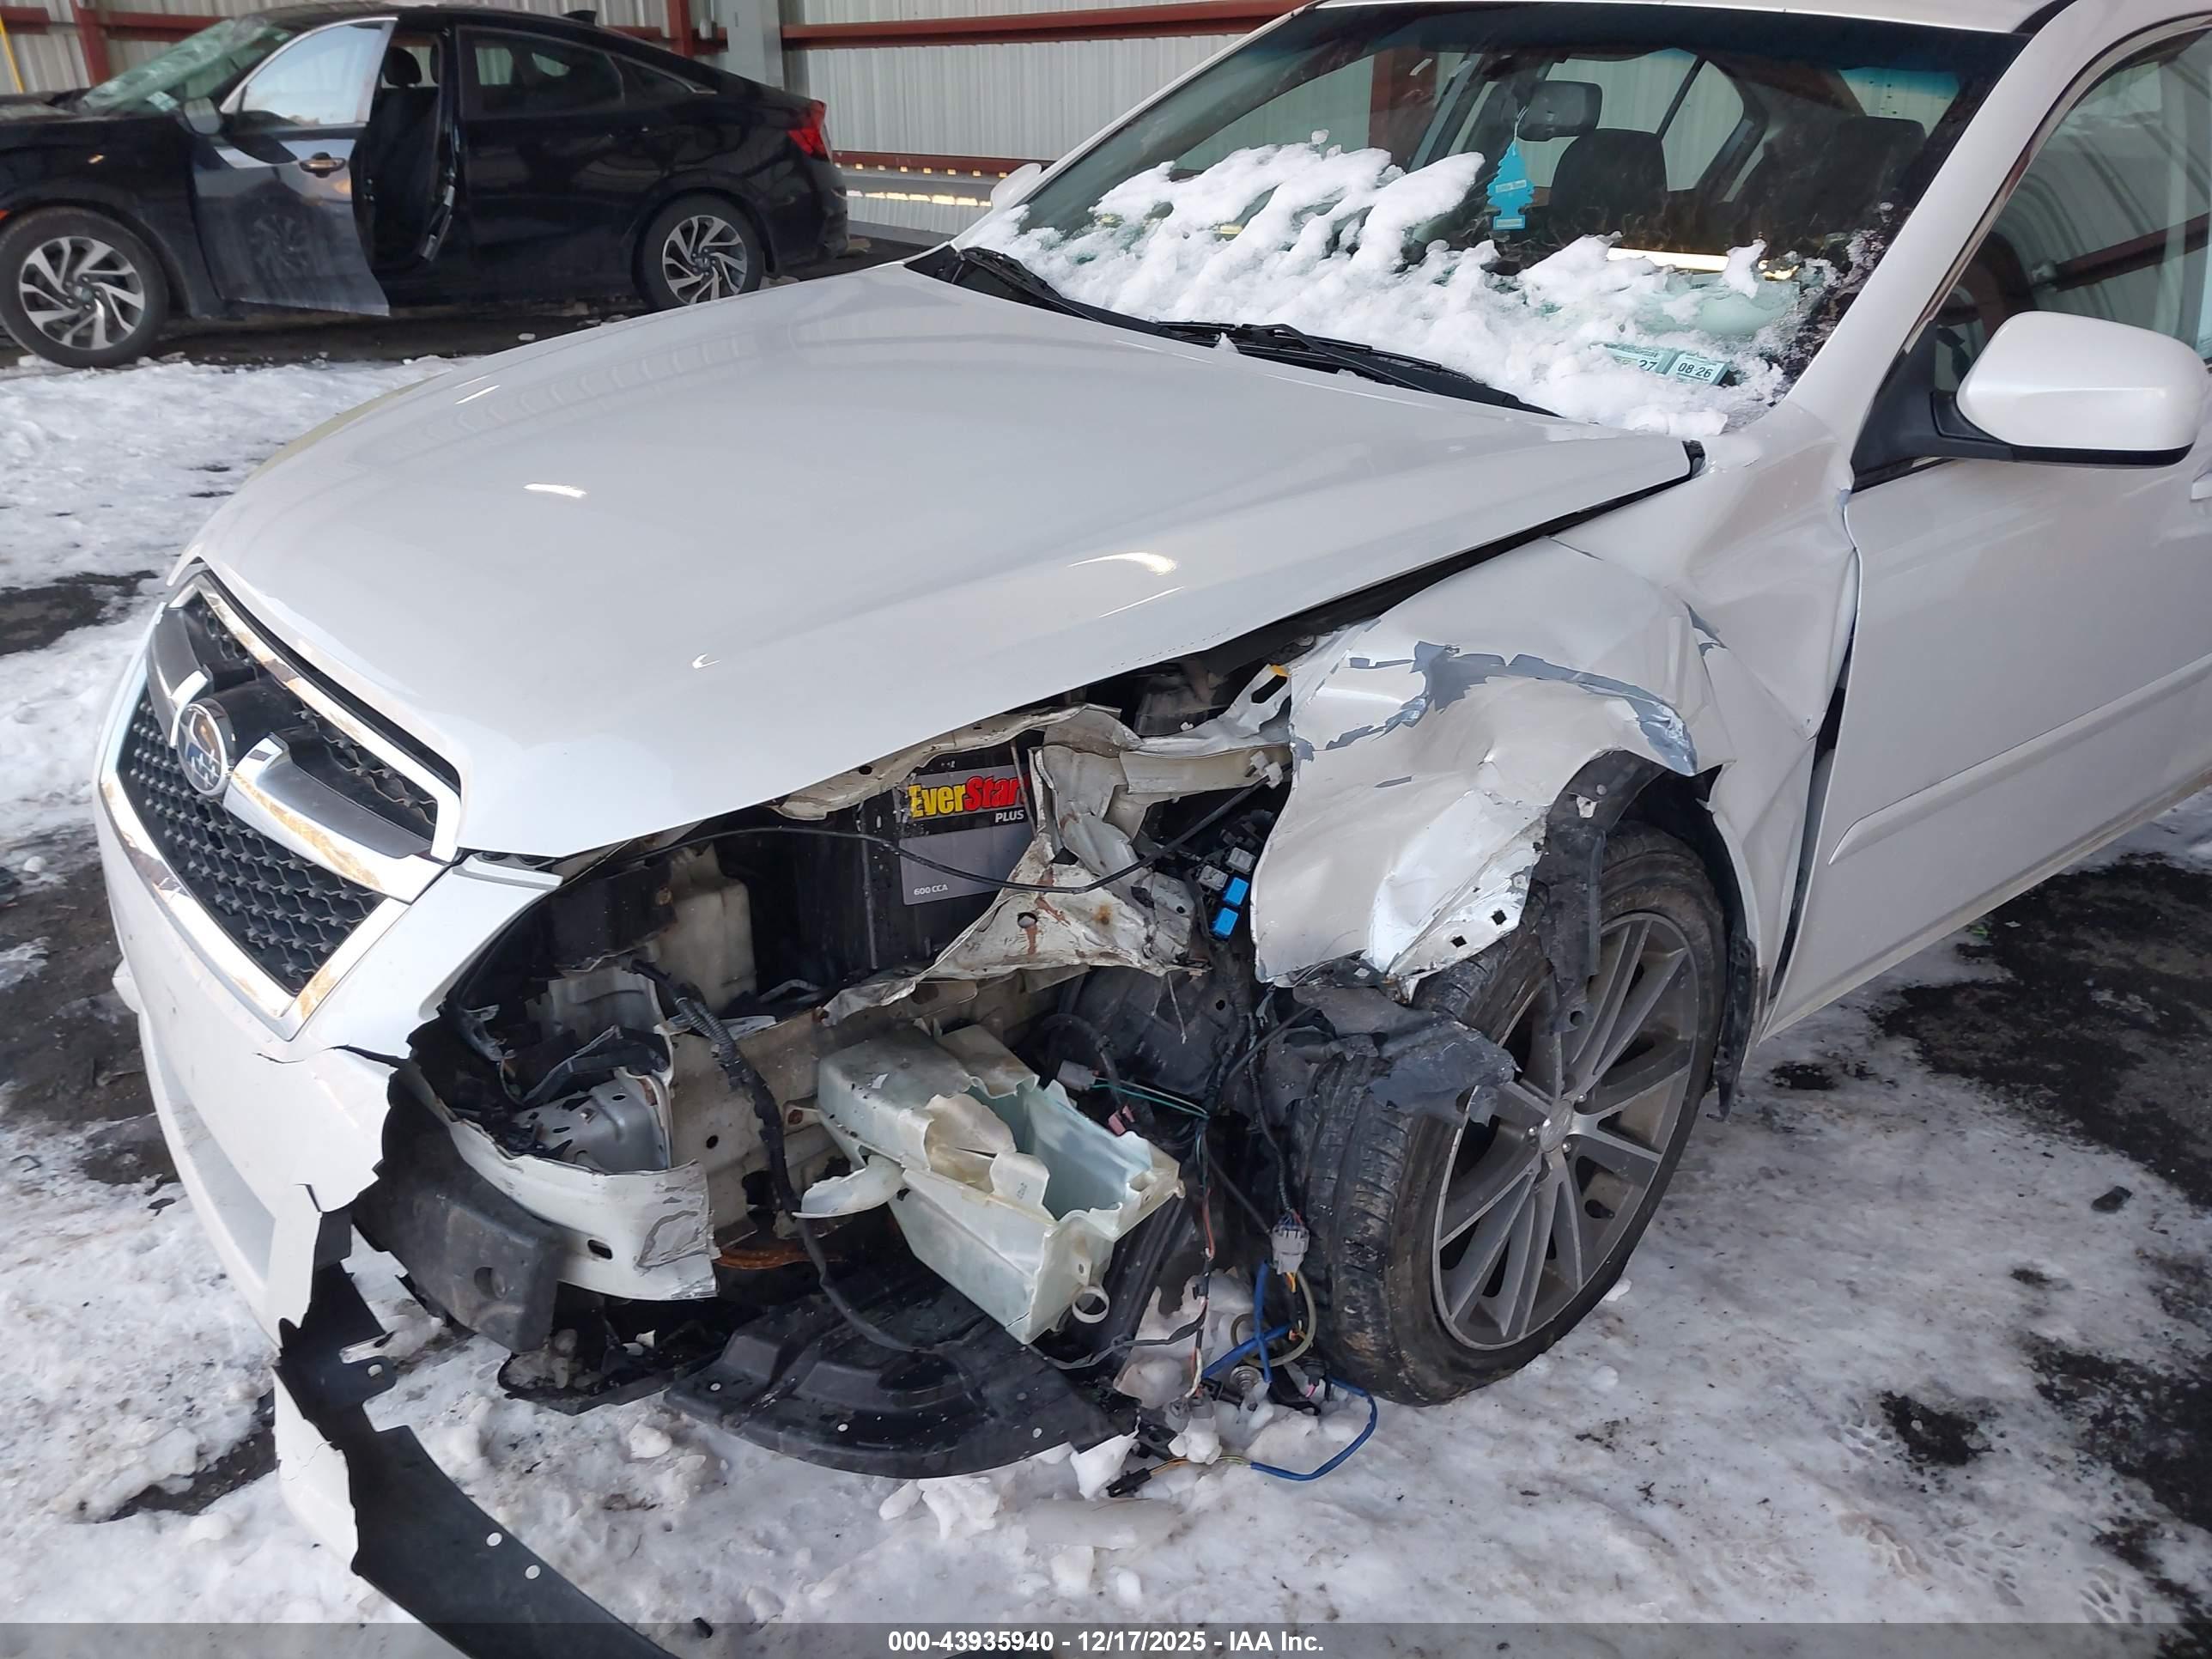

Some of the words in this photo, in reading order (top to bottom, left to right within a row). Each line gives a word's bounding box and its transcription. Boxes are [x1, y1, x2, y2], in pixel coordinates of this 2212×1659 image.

[994, 810, 1024, 823] PLUS
[914, 886, 932, 896] 600
[932, 884, 949, 894] CCA
